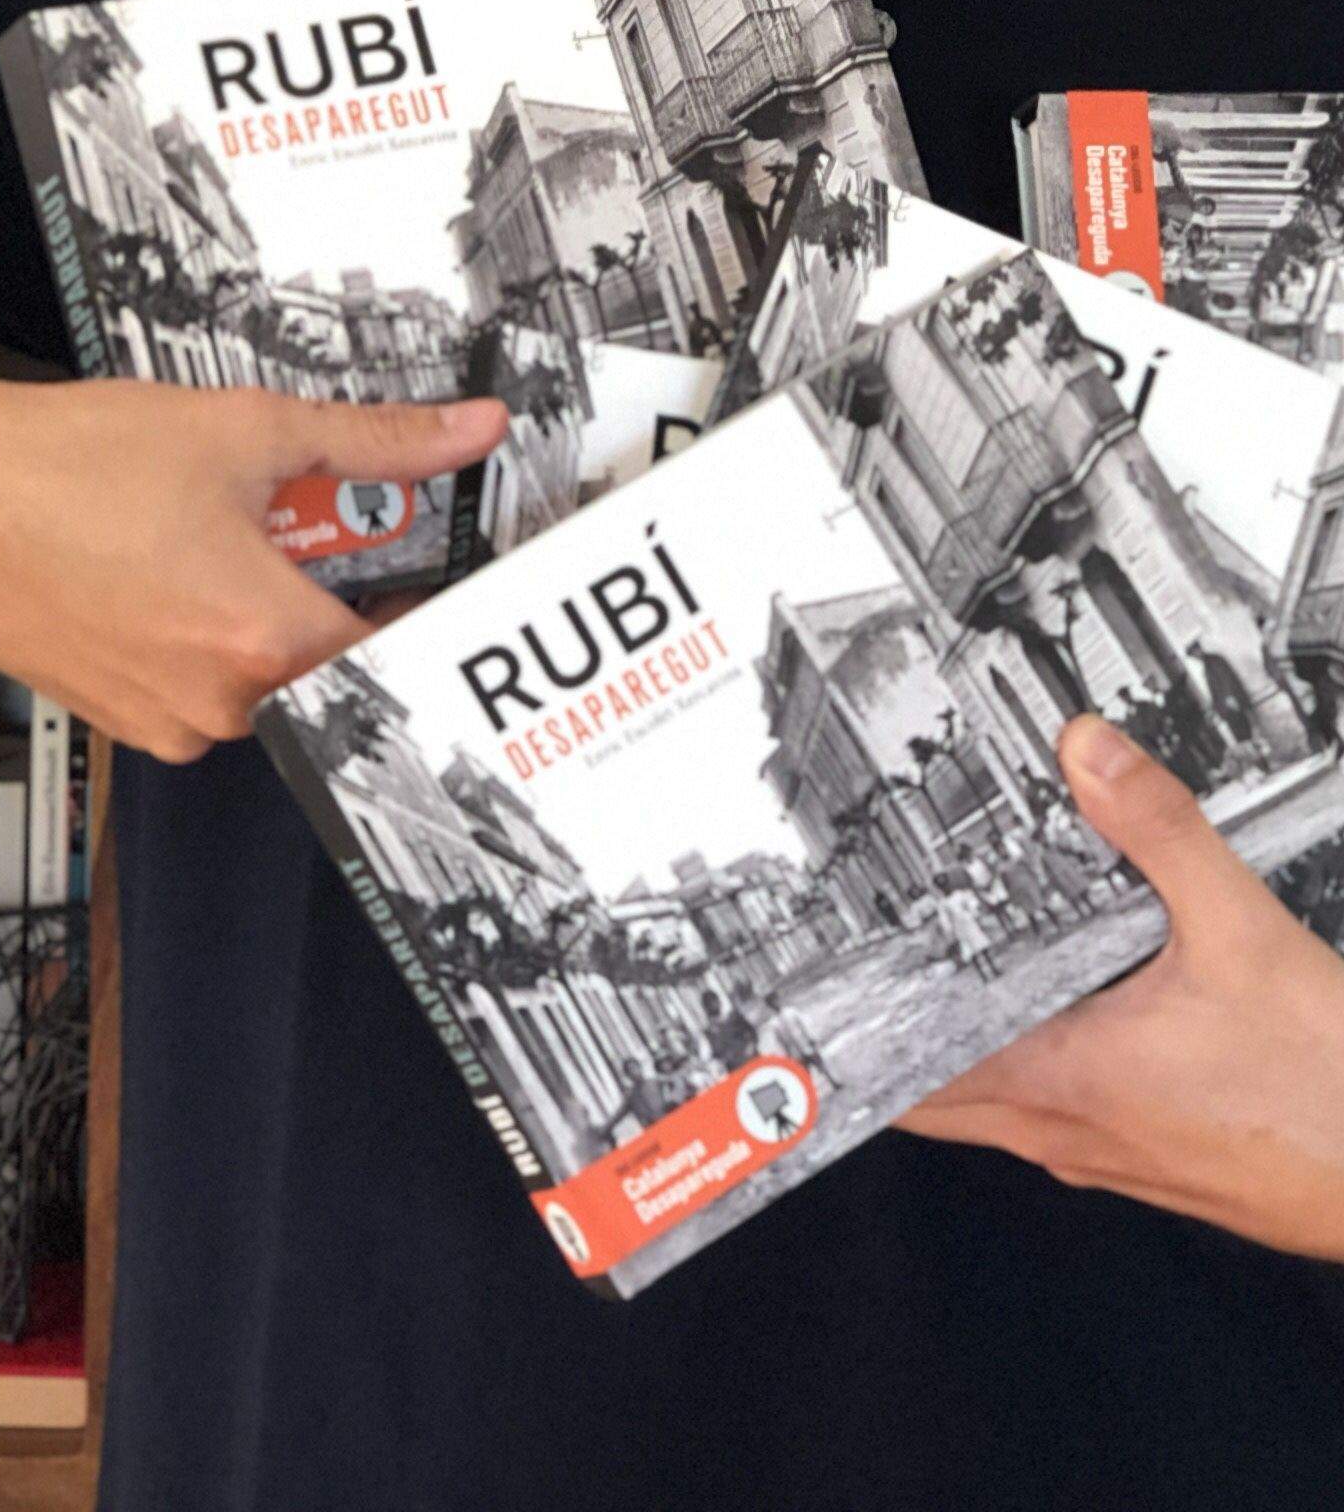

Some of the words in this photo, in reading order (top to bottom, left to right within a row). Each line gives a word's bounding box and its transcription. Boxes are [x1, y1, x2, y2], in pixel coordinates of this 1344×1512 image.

[218, 84, 451, 158] DESAPAREGUT
[1085, 145, 1113, 267] Desapareguda
[1107, 145, 1130, 230] Catalunya
[35, 174, 106, 376] SAPAREGUT
[458, 520, 701, 734] RUBÍ
[504, 619, 729, 782] DESAPAREGUT
[341, 859, 489, 1086] DESAPAREGUT
[473, 1092, 542, 1177] RUBÍ
[622, 1139, 707, 1201] Catalunya
[633, 1140, 752, 1225] Desapareguda
